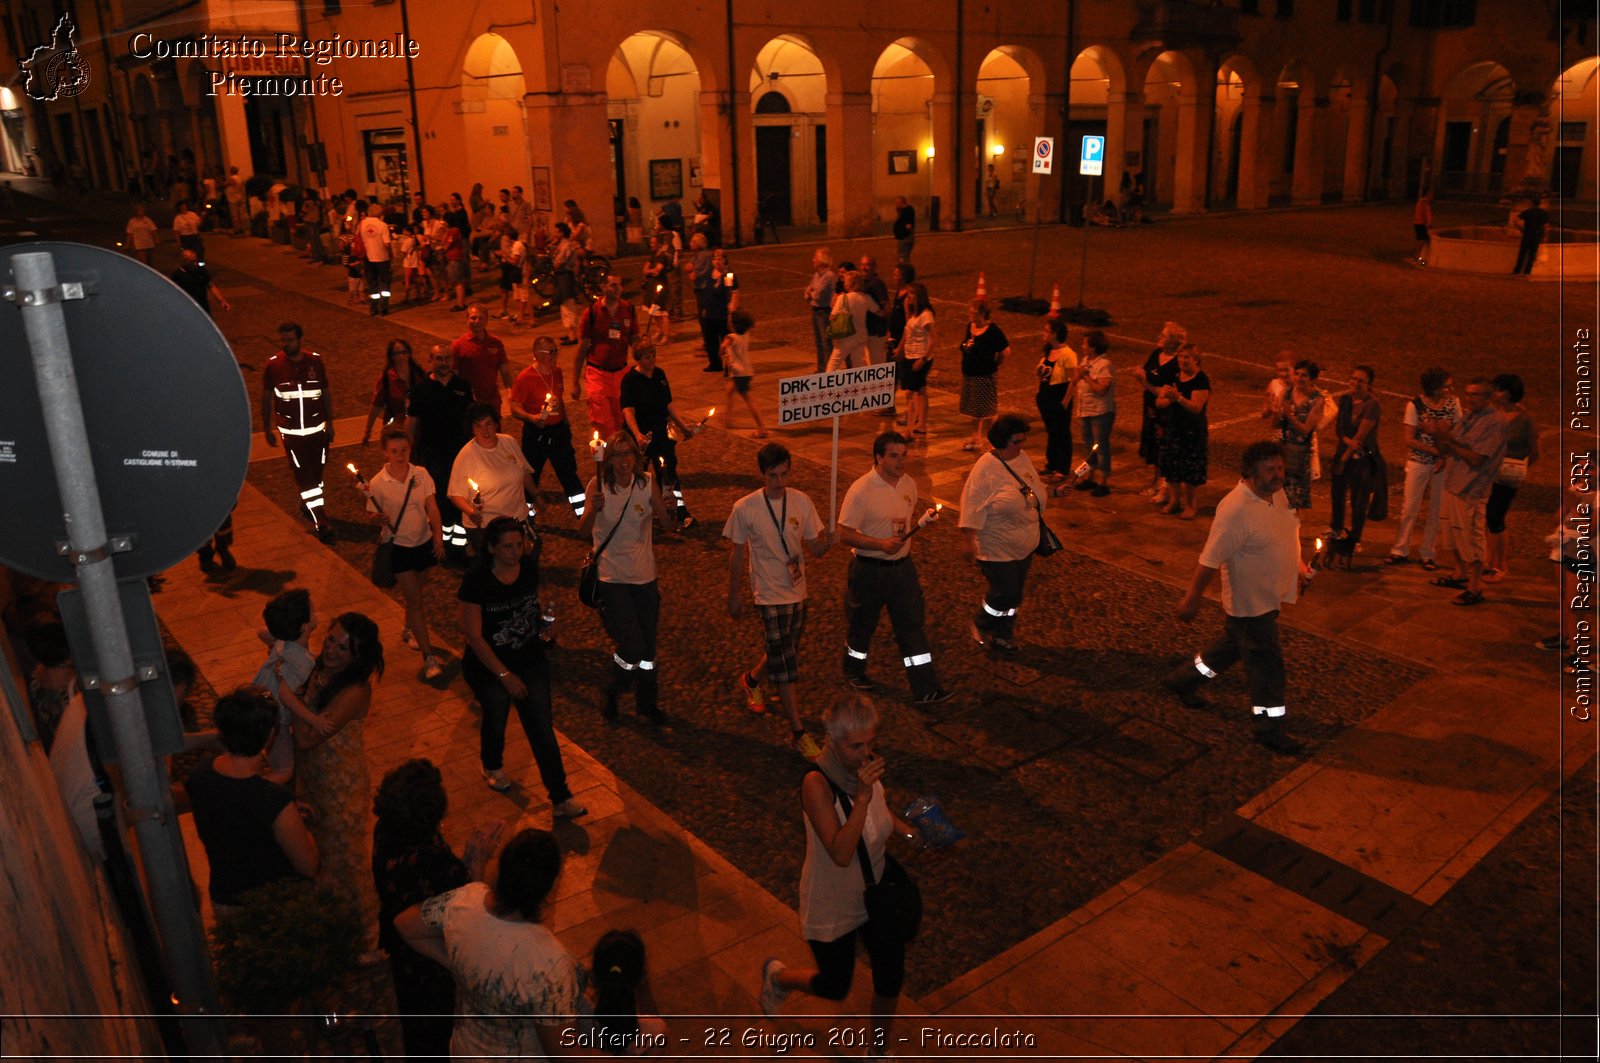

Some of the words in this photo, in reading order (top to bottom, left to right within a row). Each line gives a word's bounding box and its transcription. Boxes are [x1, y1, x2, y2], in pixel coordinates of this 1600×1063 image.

[224, 55, 301, 73] LIBRERIA
[1085, 138, 1101, 160] P
[781, 366, 895, 395] DRK-LEUTKIRCH
[782, 393, 892, 423] DEUTSCHLAND
[142, 450, 169, 458] COMUNE
